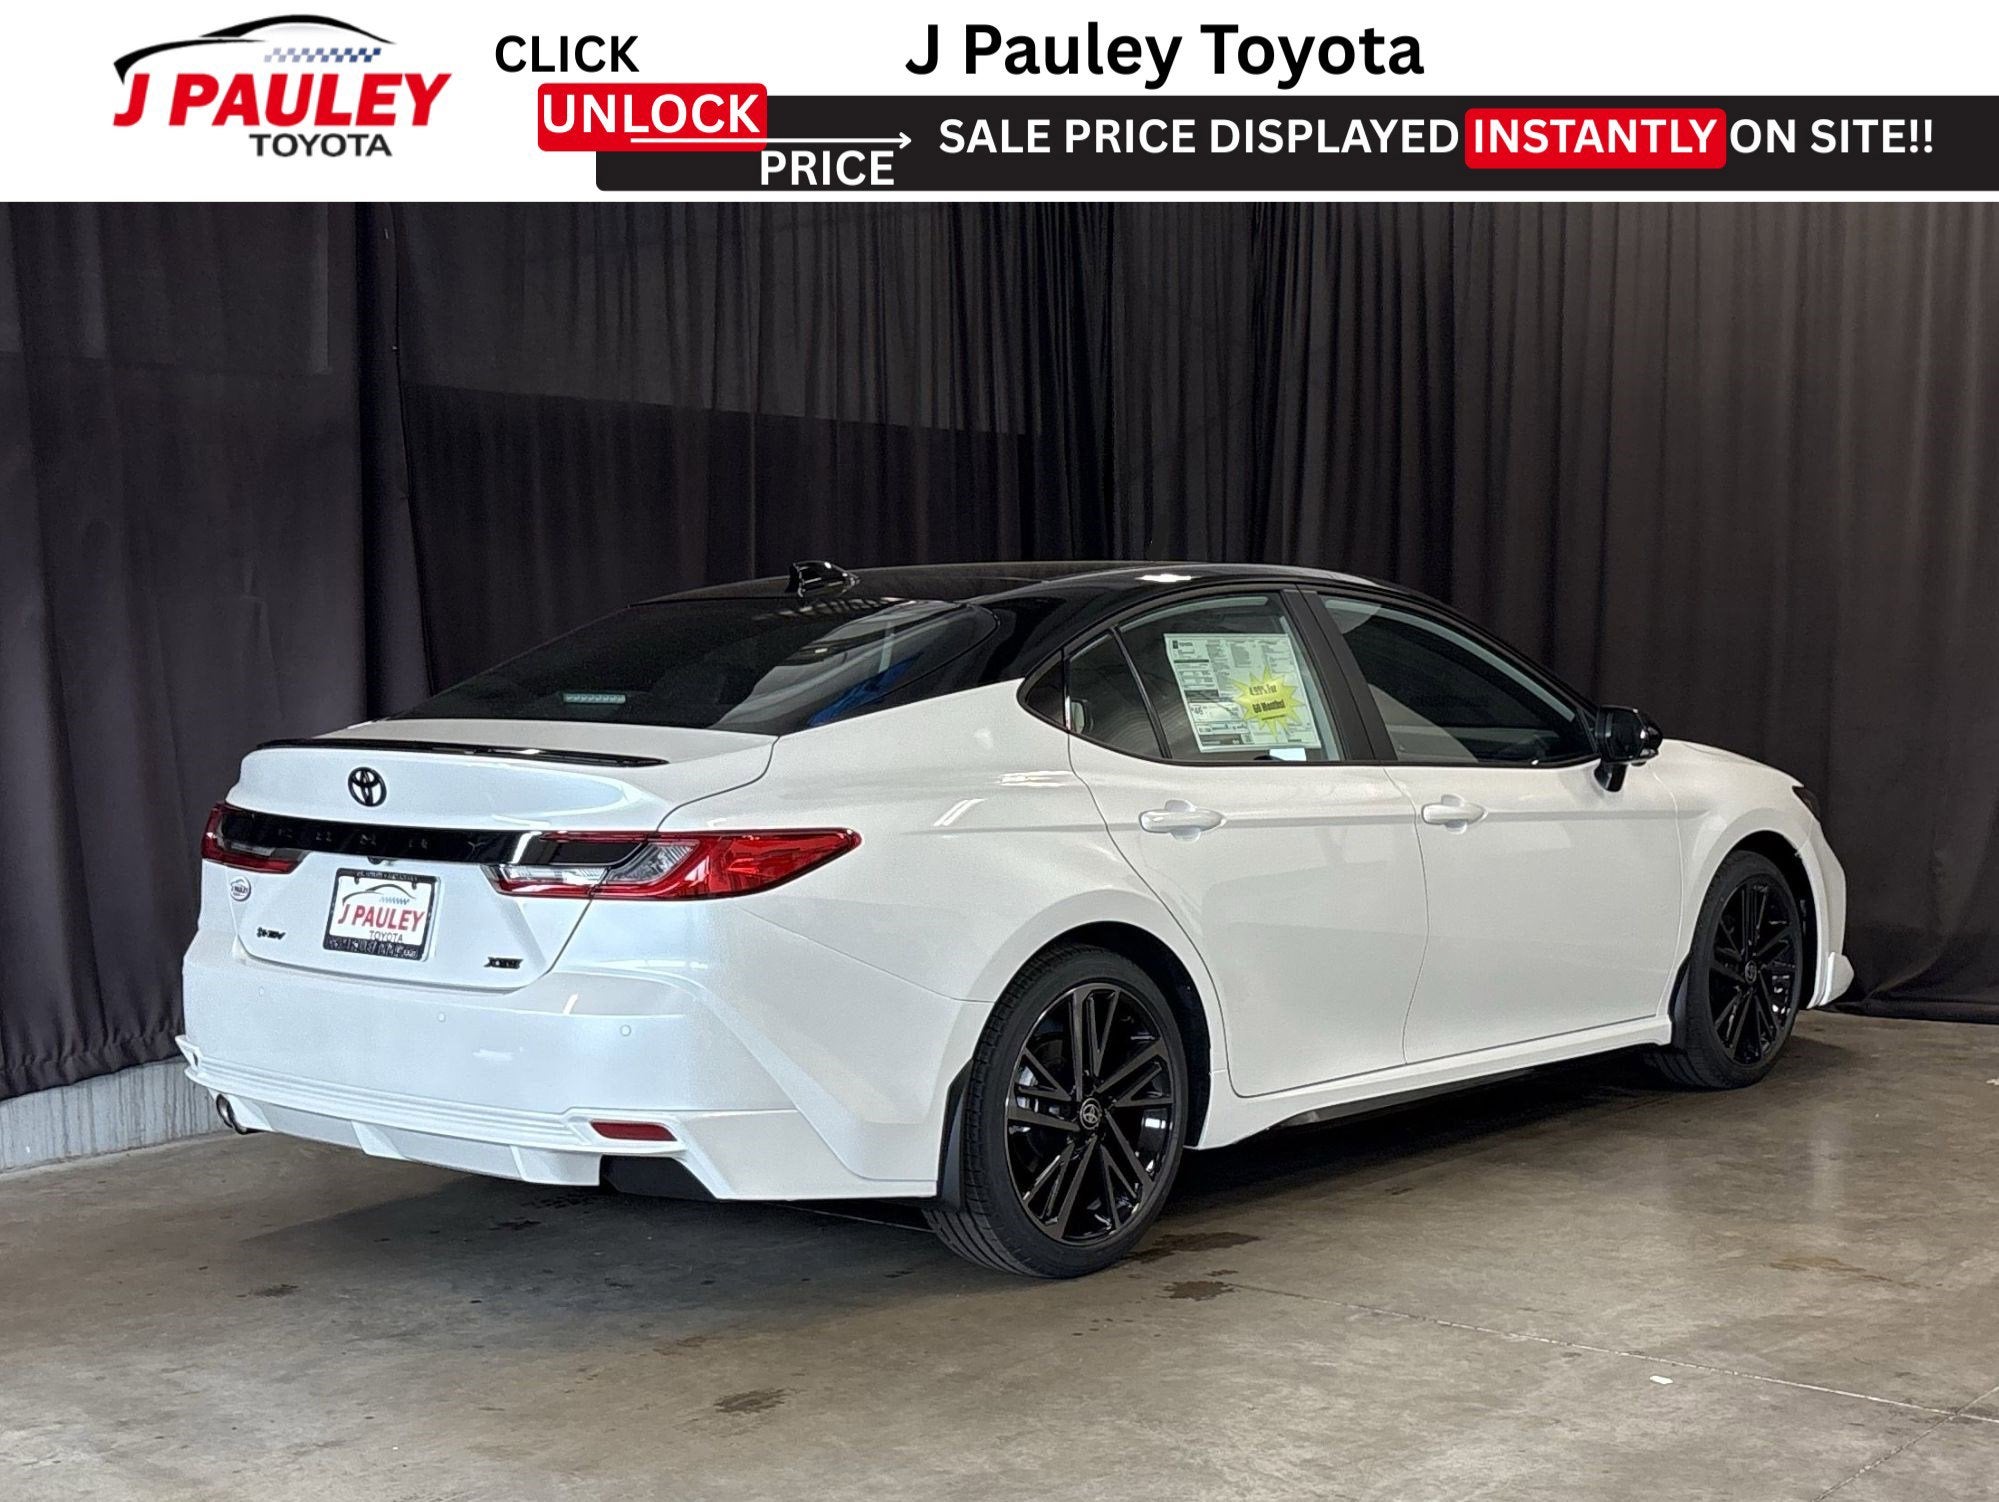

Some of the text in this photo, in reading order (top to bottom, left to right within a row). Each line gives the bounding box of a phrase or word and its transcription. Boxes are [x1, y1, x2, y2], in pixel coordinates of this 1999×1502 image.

[337, 903, 425, 932] J PAULEY
[369, 930, 404, 942] TOYOTA
